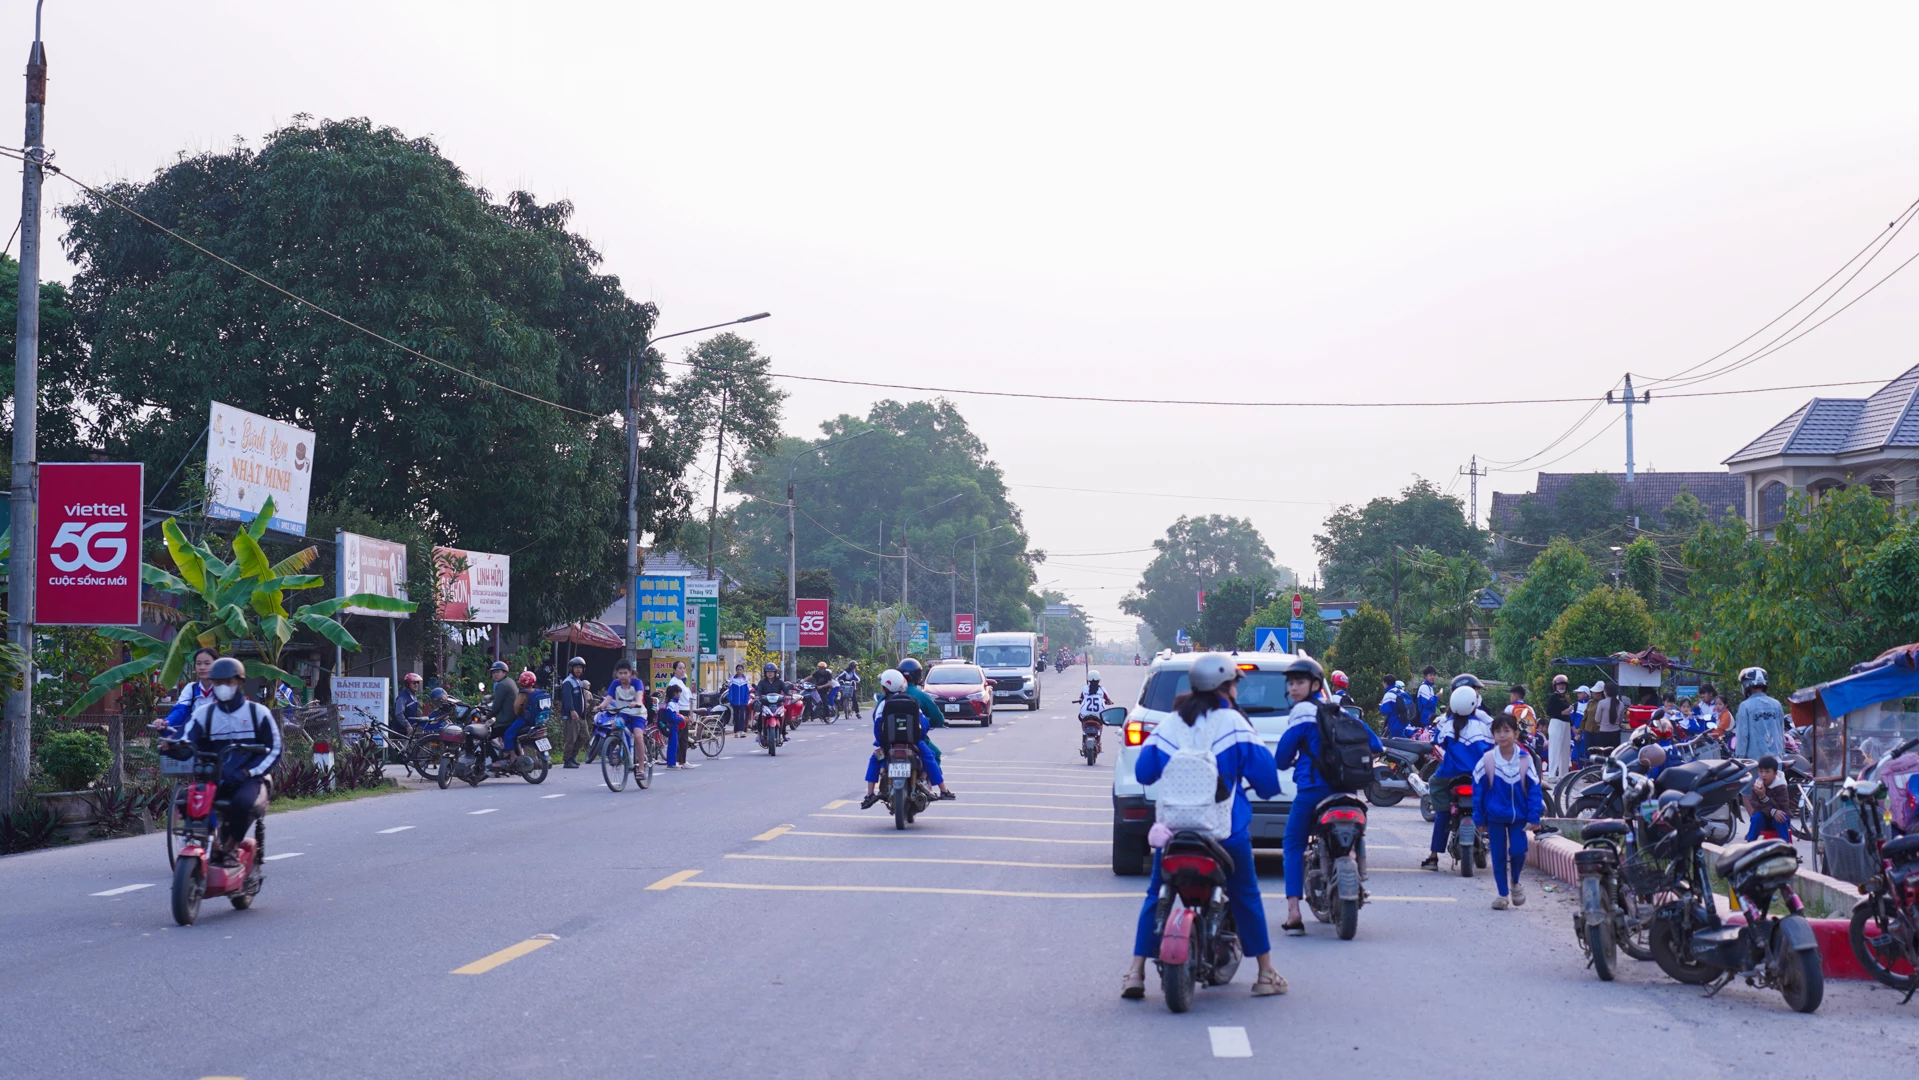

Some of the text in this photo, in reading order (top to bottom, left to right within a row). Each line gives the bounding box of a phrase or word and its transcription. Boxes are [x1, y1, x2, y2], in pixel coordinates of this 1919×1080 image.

[231, 455, 293, 493] NHẬT MINH
[64, 502, 128, 517] viettel
[50, 522, 128, 573] 5G
[49, 574, 128, 586] CUỘC SỐNG MỚI
[476, 567, 490, 586] LINH
[800, 616, 825, 632] 5G
[957, 624, 972, 633] 5G
[336, 680, 381, 689] BÁNH KEM
[334, 689, 382, 700] NHẬT MINH
[1086, 697, 1100, 712] 25
